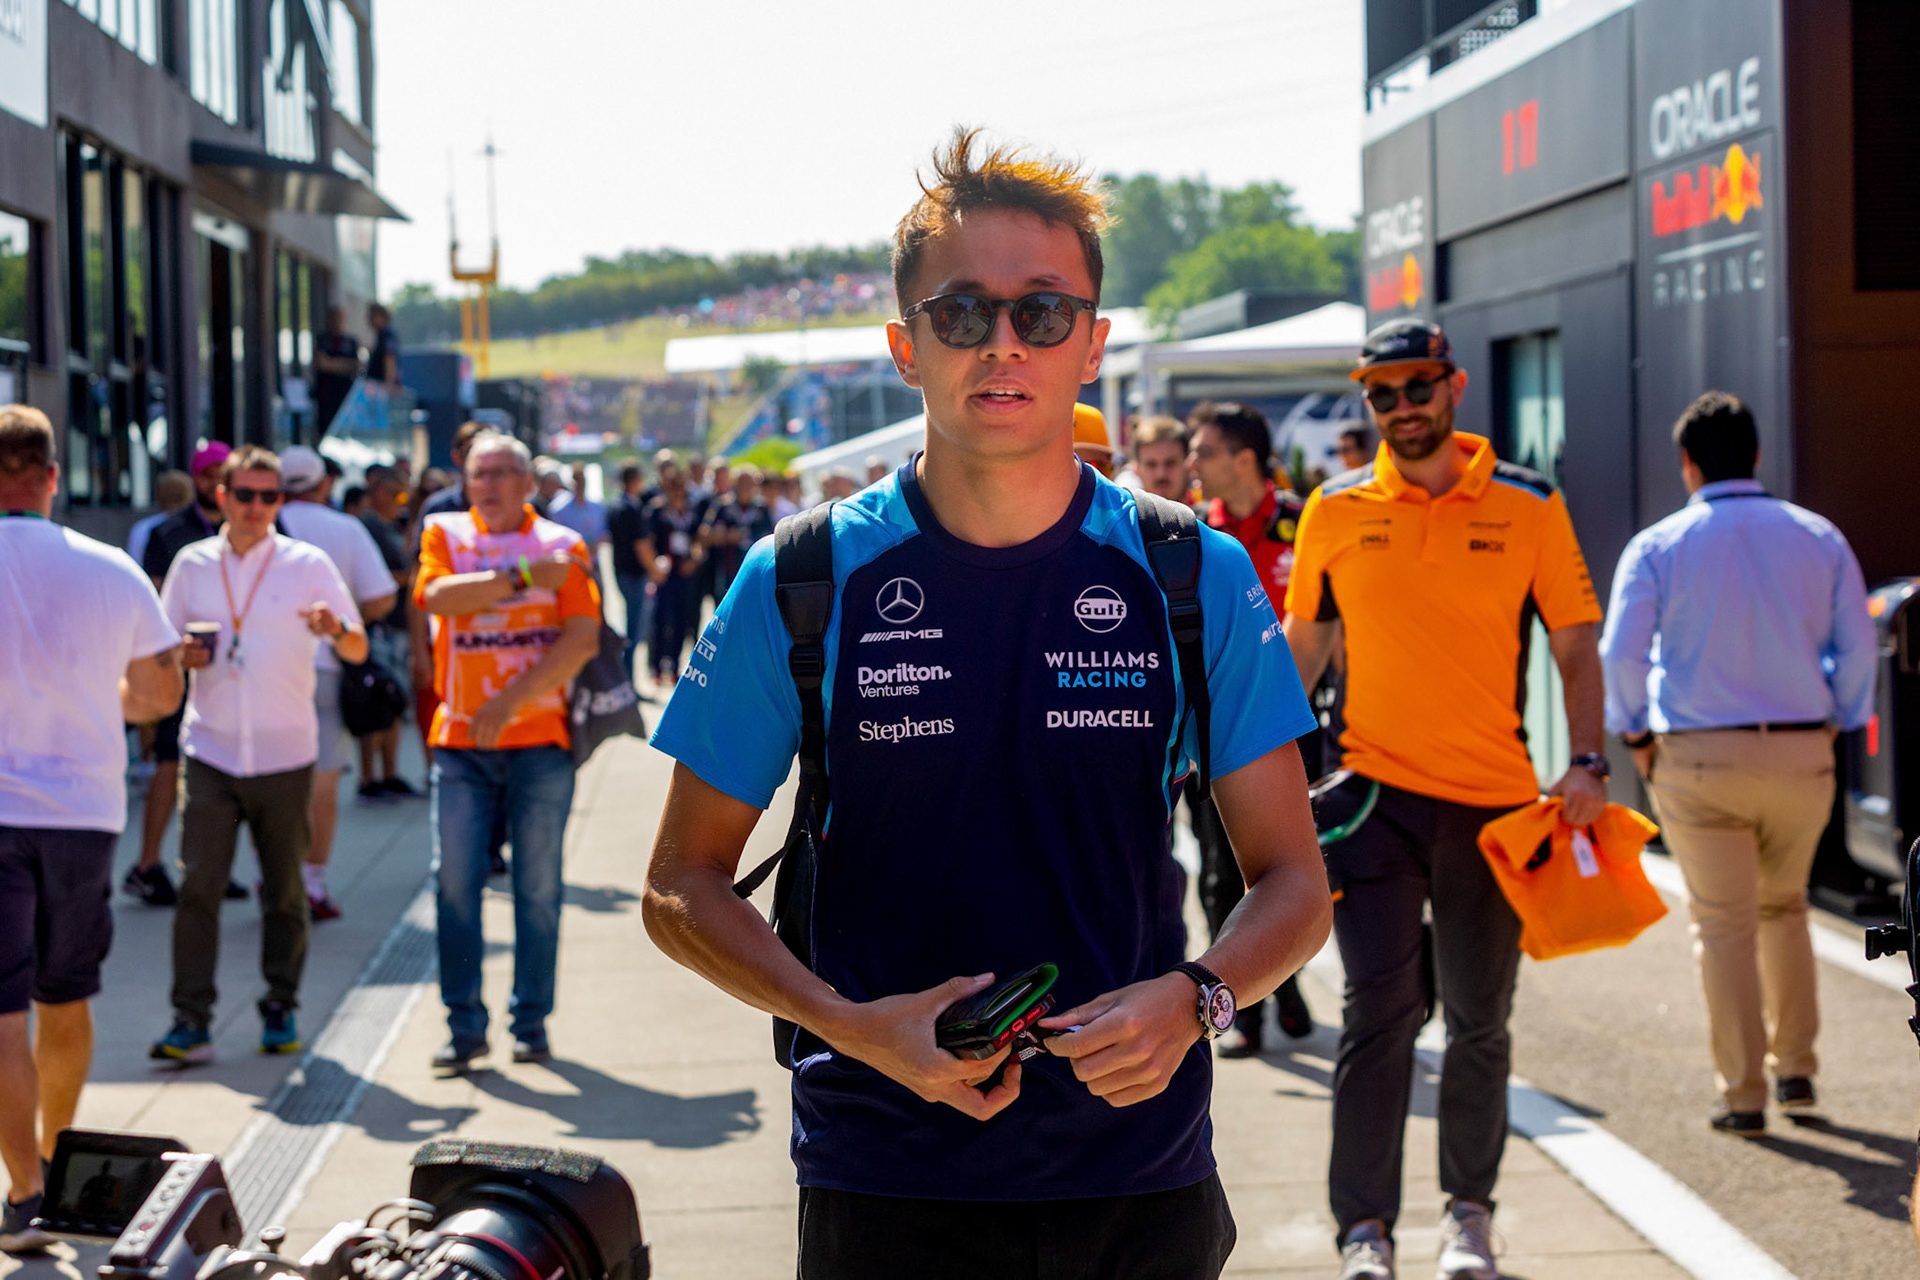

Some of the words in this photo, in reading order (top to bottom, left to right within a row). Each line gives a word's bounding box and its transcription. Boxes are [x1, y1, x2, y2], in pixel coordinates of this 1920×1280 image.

[1650, 56, 1761, 159] ORACLE
[1652, 249, 1766, 305] RACING
[1076, 601, 1126, 617] Gulf
[886, 629, 943, 641] AMG
[1044, 651, 1160, 669] WILLIAMS
[1057, 671, 1147, 688] RACING
[858, 685, 920, 698] Ventures
[1046, 710, 1154, 728] DURACELL
[858, 716, 955, 743] Stephens
